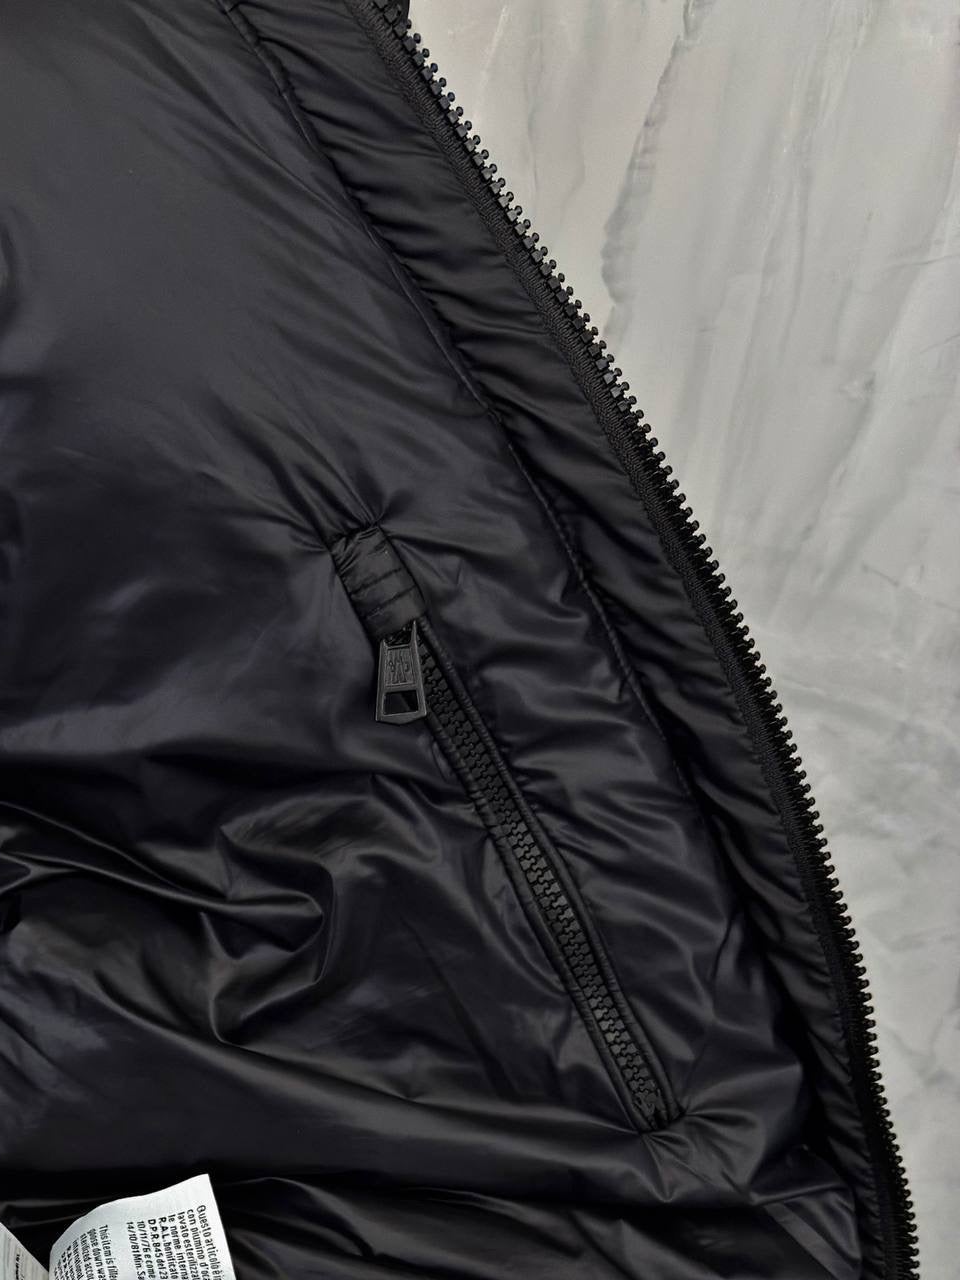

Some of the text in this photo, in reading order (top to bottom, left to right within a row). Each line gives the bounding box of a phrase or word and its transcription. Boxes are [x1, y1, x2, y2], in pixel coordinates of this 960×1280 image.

[168, 1214, 176, 1222] le
[177, 1212, 189, 1237] lavato
[187, 1209, 196, 1225] con
[99, 1225, 110, 1240] This
[170, 1226, 181, 1249] norme
[197, 1205, 212, 1237] Questo
[205, 1239, 220, 1269] articolo
[101, 1240, 112, 1256] item
[137, 1221, 150, 1252] 10/11/76
[146, 1260, 155, 1278] come
[153, 1242, 163, 1258] 845
[191, 1227, 205, 1259] piumino
[92, 1248, 103, 1267] down
[157, 1259, 166, 1269] del
